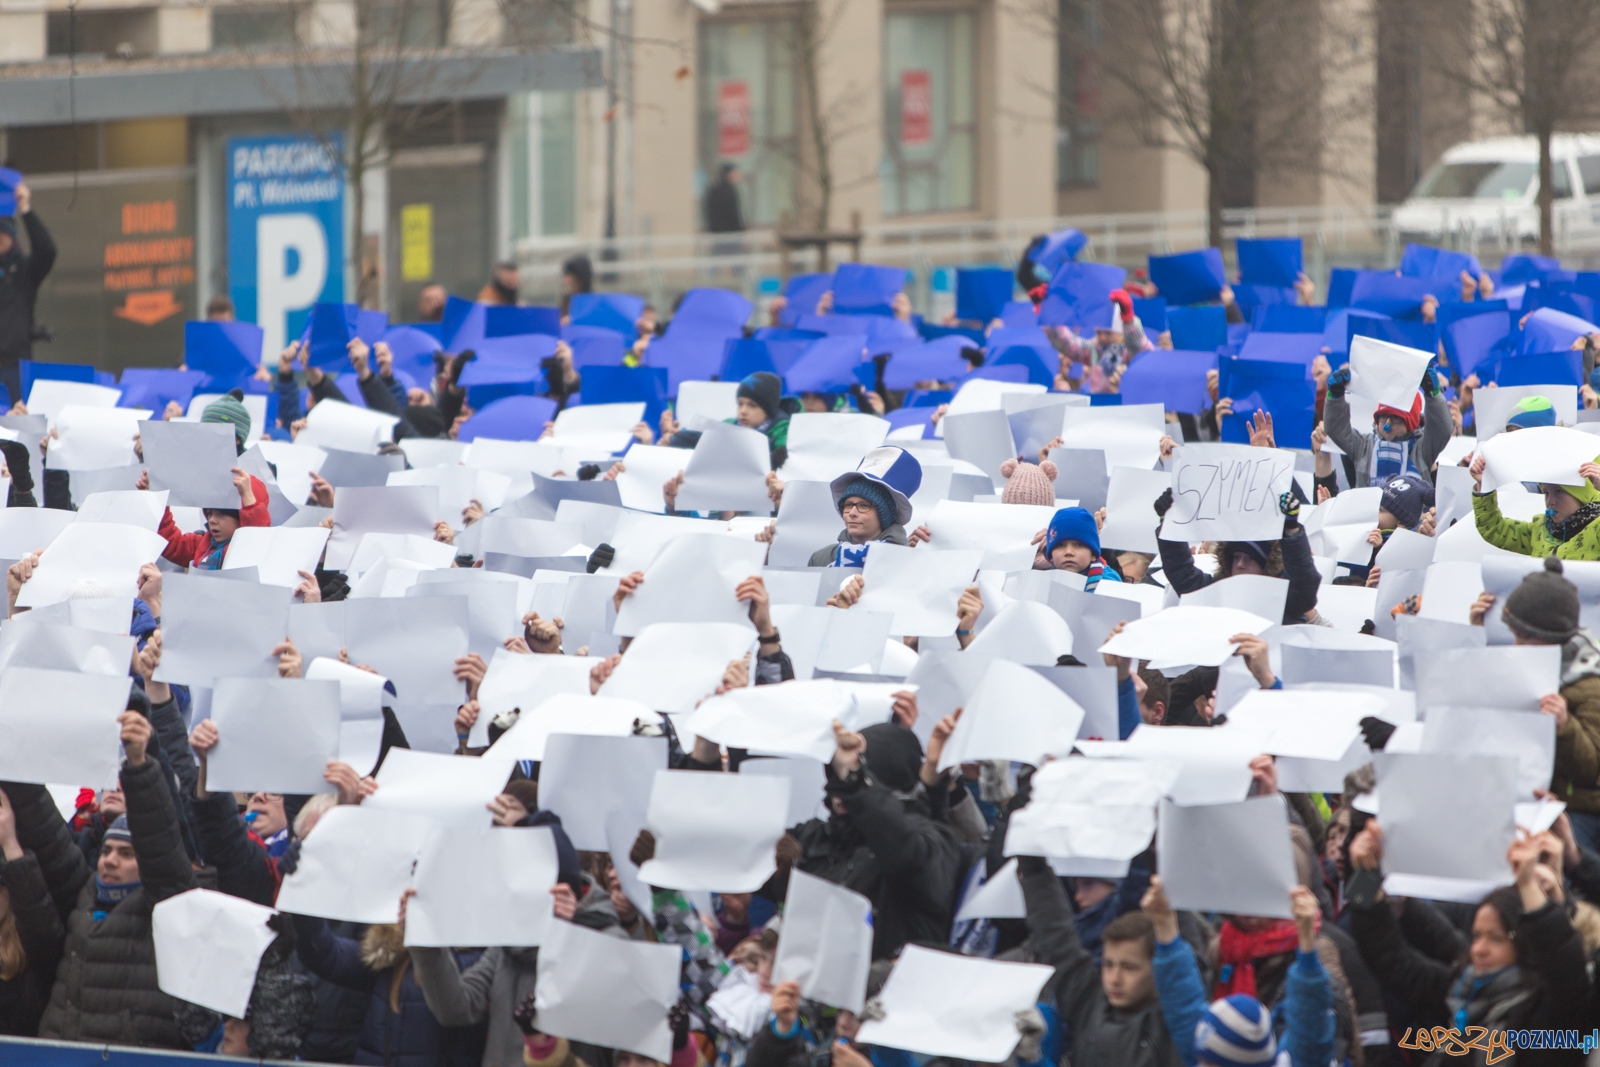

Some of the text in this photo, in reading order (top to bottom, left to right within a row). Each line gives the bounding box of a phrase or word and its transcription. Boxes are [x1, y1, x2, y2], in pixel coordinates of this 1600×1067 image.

[234, 143, 335, 178] PARKING
[257, 213, 328, 366] P
[1173, 458, 1290, 524] SZYMEK
